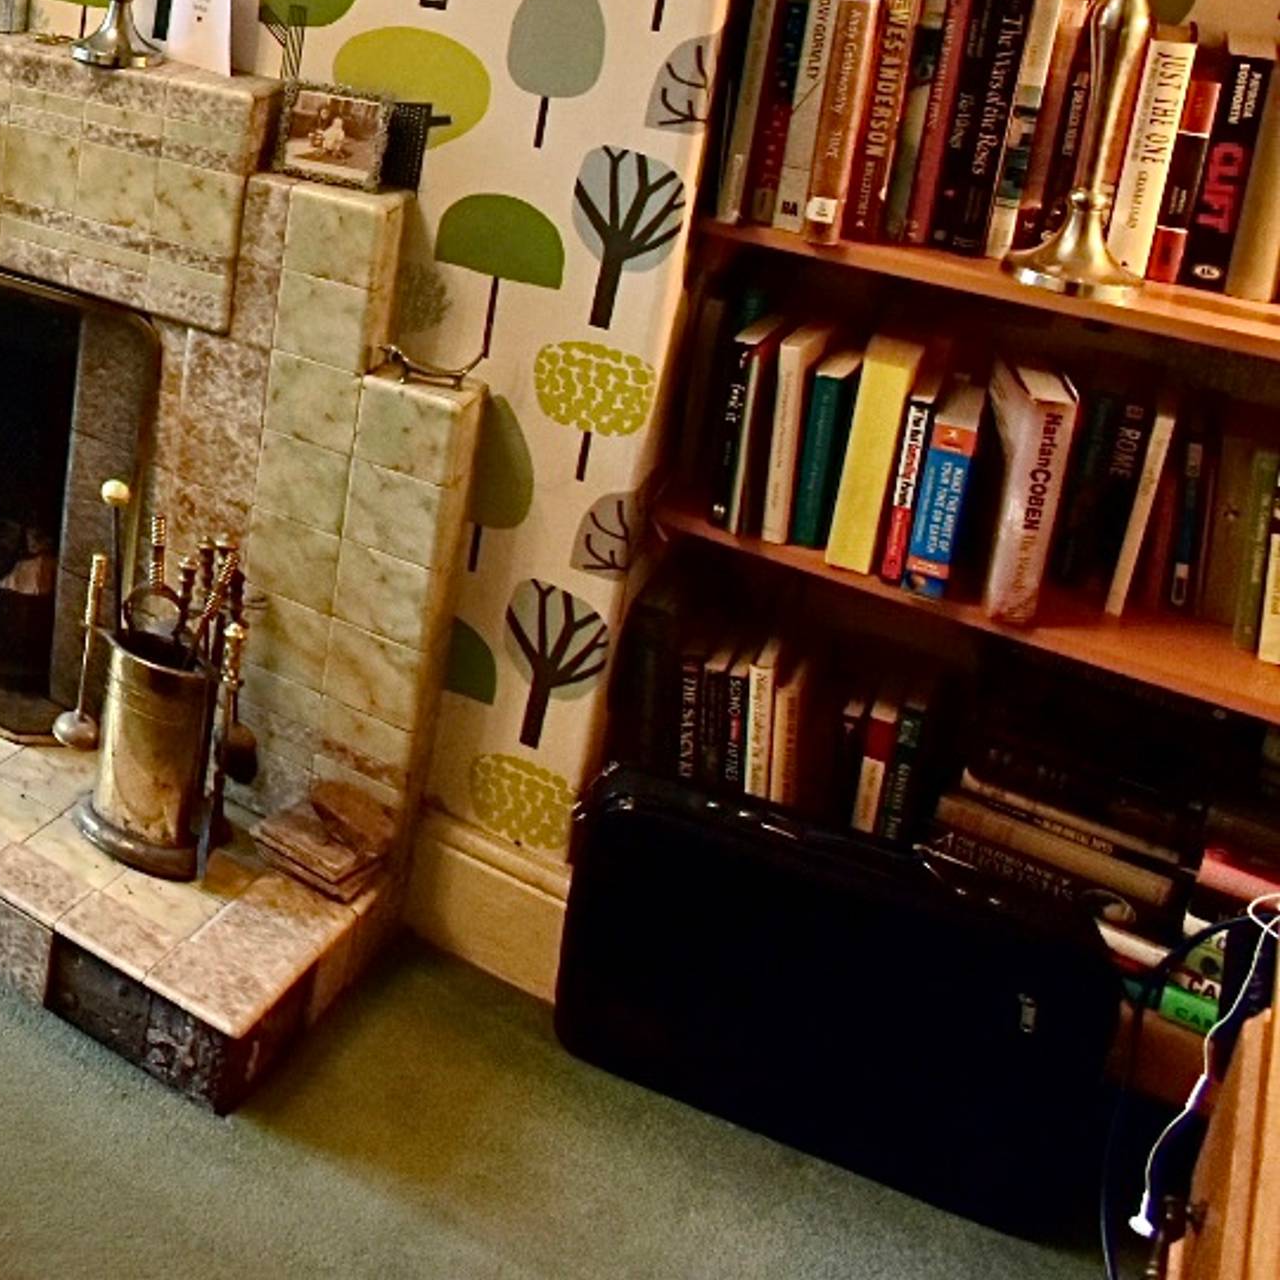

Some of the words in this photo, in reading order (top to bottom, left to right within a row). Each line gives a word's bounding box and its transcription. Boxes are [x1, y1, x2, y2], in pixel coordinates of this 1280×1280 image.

[884, 6, 911, 52] WES
[998, 11, 1026, 49] The
[806, 23, 827, 80] GORMLEY
[989, 47, 1015, 91] Wars
[1154, 51, 1187, 92] JUST
[864, 54, 900, 158] ANDERSON
[980, 106, 1004, 131] the
[1149, 96, 1178, 128] THE
[971, 131, 998, 178] Roses
[1140, 131, 1169, 167] ONE
[1038, 412, 1063, 468] Harlan
[1110, 426, 1141, 478] ROME
[1022, 467, 1052, 531] COBEN
[681, 677, 696, 705] THE
[726, 679, 742, 716] SOHO
